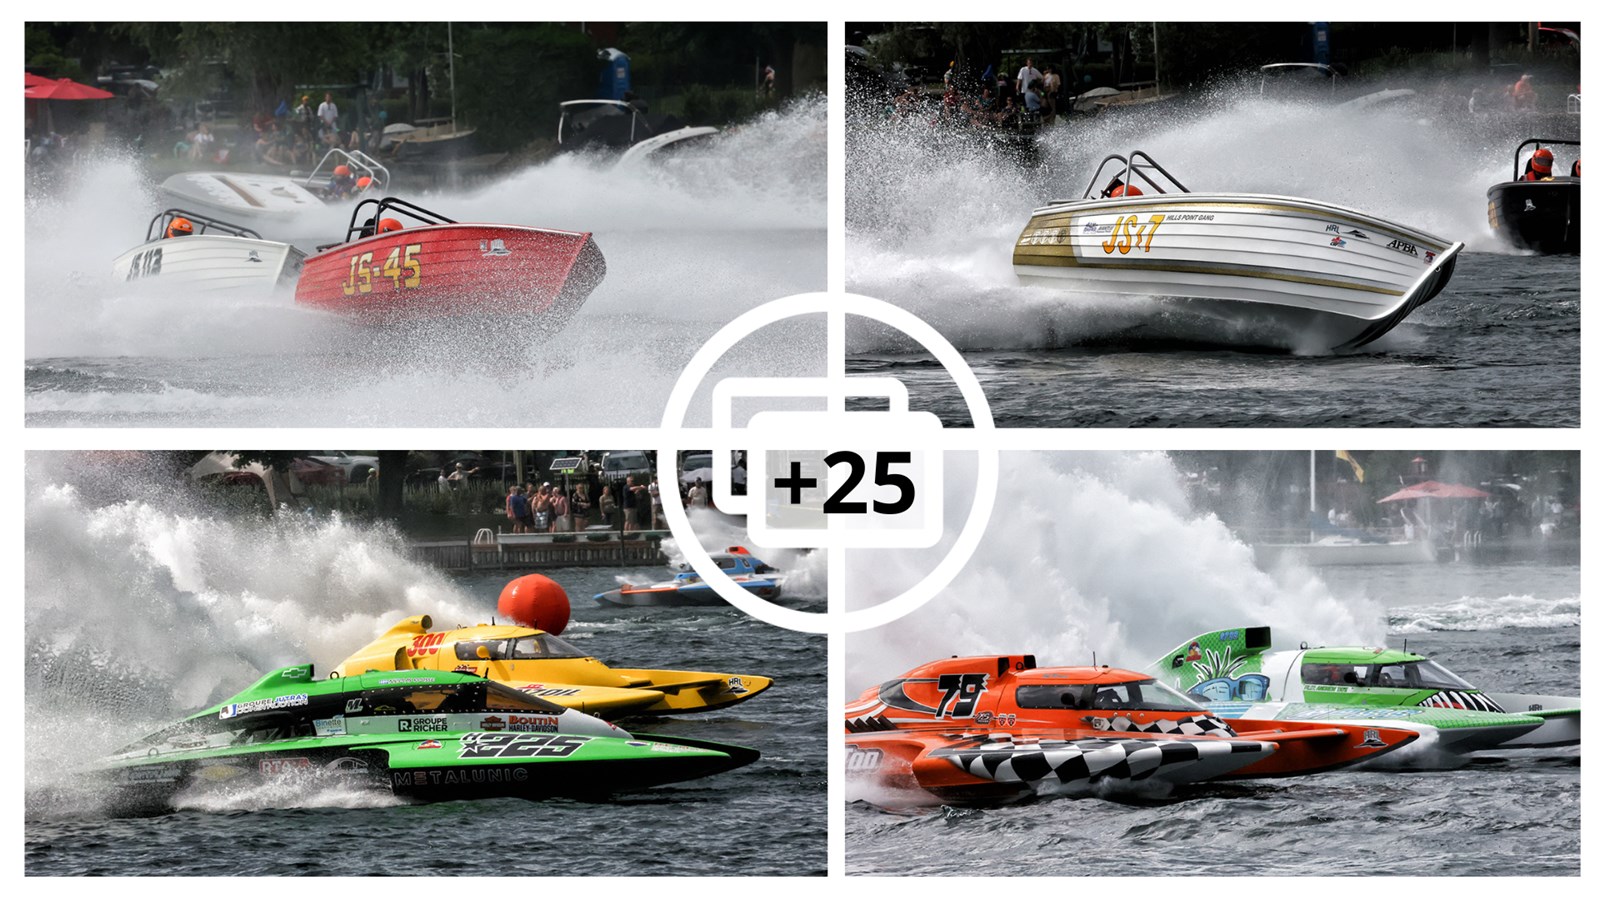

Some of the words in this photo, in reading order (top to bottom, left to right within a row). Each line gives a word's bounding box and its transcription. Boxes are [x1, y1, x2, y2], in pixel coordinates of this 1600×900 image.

[1386, 239, 1418, 256] APBA
[341, 242, 422, 297] JS-45
[407, 633, 445, 657] 300
[237, 698, 272, 709] GROUPE
[274, 693, 308, 703] JUTRAS
[935, 673, 990, 719] 79
[413, 724, 448, 732] RICHER
[508, 724, 559, 733] HARLEY-DAVIDSON
[458, 733, 594, 759] 225
